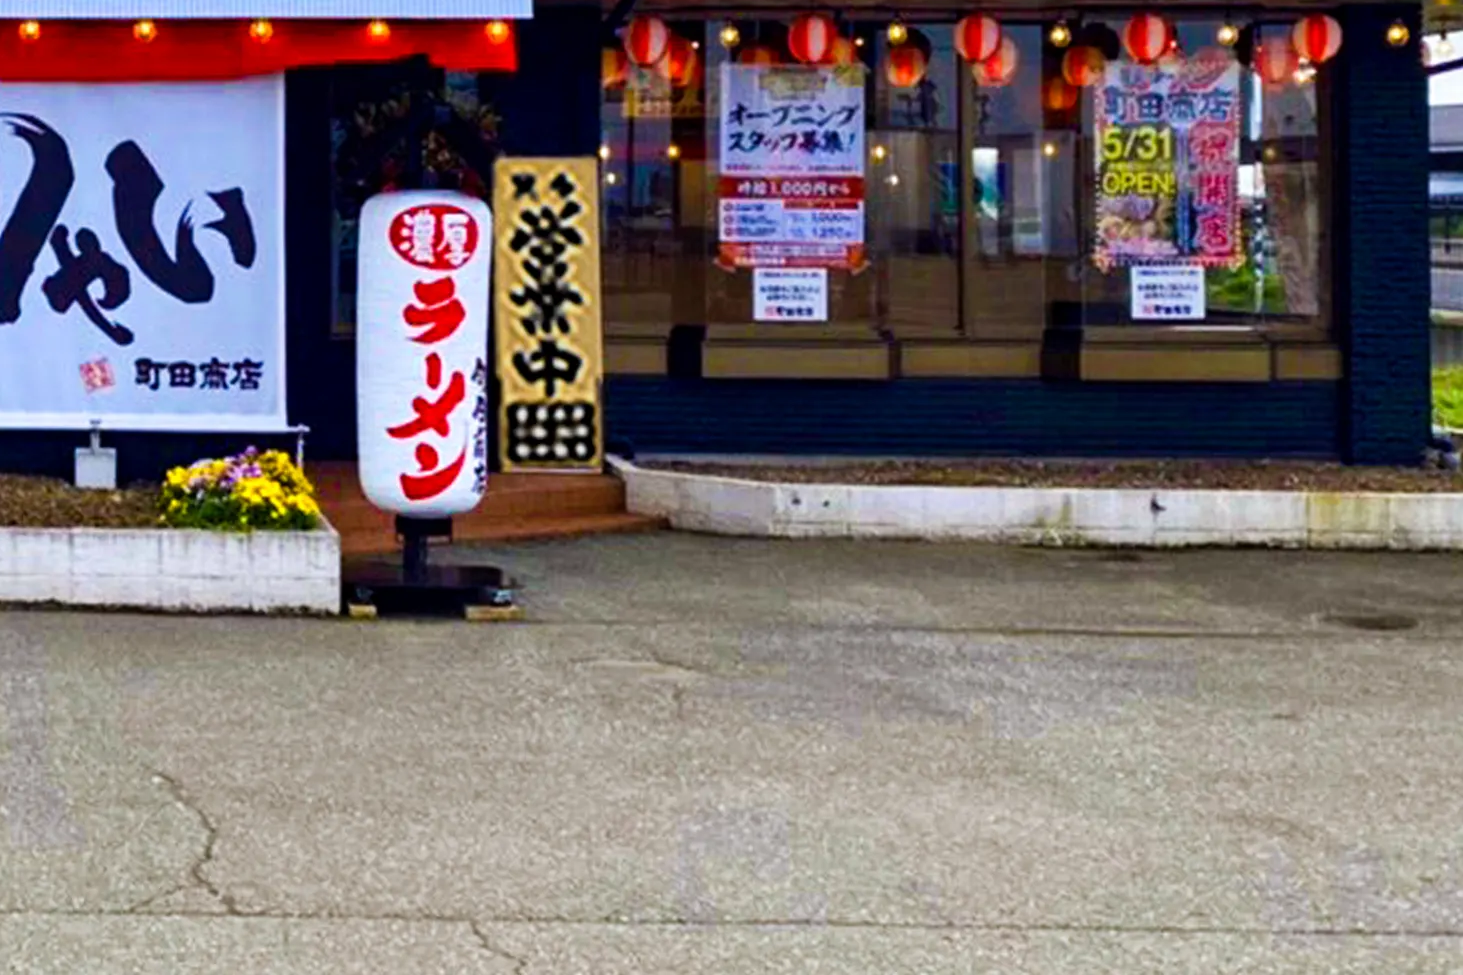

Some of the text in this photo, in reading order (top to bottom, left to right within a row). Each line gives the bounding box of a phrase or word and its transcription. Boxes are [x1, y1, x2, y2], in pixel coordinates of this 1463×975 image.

[728, 102, 860, 128] オープニング
[1104, 86, 1233, 122] 町田商店
[1103, 126, 1172, 160] 5/31
[1102, 171, 1177, 195] OPEN!
[399, 209, 470, 265] 濃厚
[134, 356, 264, 391] 町田商店
[386, 275, 467, 500] ラーメン
